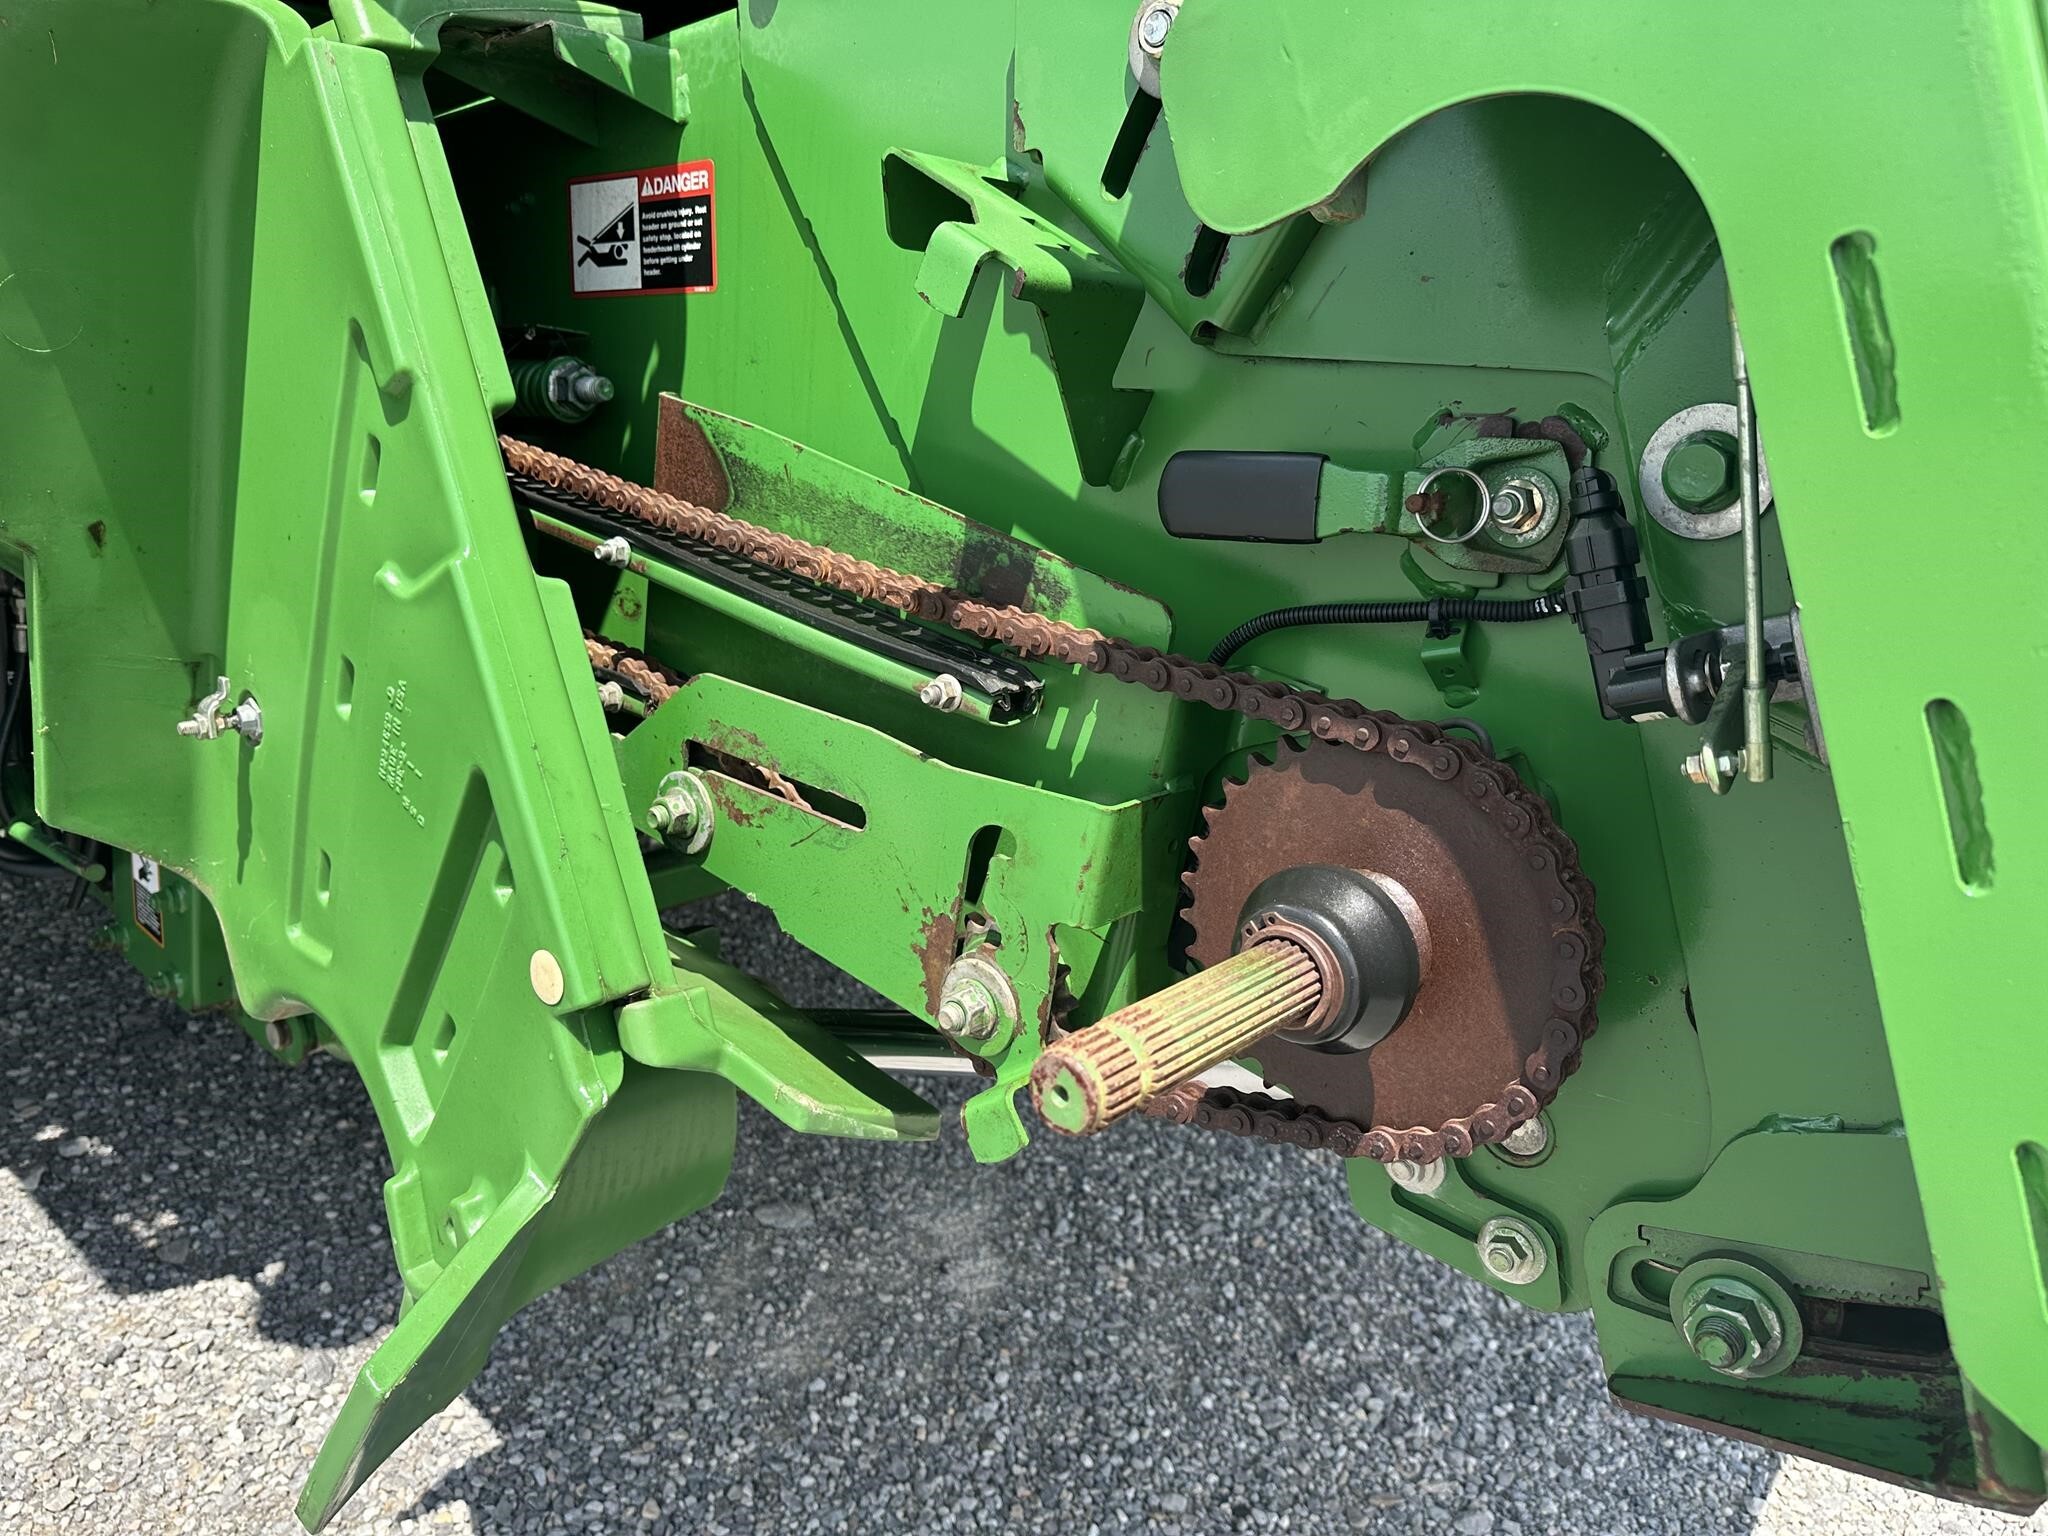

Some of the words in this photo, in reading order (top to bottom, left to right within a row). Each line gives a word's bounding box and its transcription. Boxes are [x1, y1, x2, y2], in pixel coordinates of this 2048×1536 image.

[654, 170, 709, 196] DANGER
[642, 211, 656, 219] Avoid
[656, 209, 677, 218] crushing
[642, 223, 659, 231] header
[668, 219, 687, 230] ground
[643, 234, 658, 243] safety
[673, 230, 693, 239] located
[694, 230, 702, 238] on
[681, 242, 701, 252] cylinder
[643, 257, 659, 265] before
[660, 255, 677, 265] getting
[678, 254, 693, 263] under
[395, 680, 407, 711] USA
